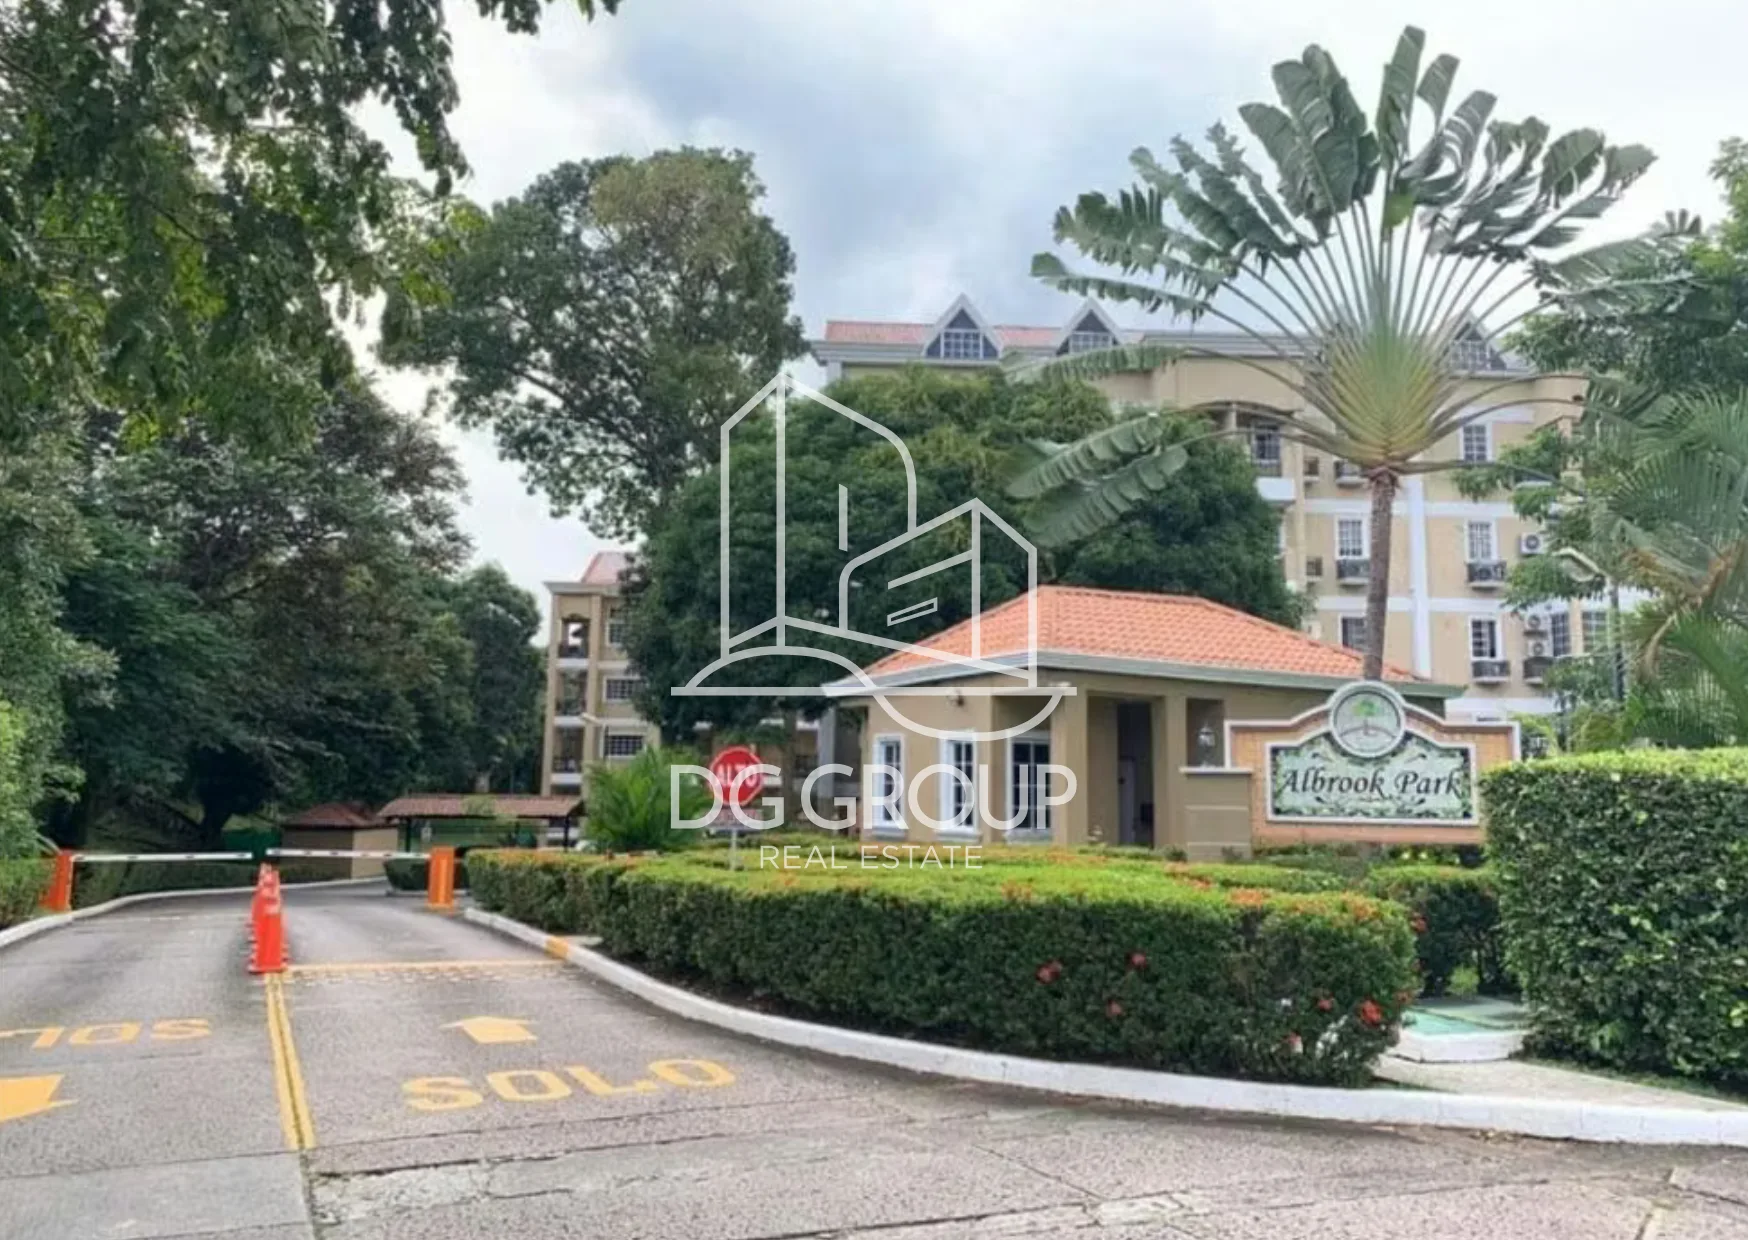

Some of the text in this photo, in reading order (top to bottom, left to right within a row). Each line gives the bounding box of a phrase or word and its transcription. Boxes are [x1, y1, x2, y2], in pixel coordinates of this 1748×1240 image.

[714, 763, 759, 788] ALTO
[1283, 766, 1463, 799] Albrook Park
[402, 1057, 736, 1112] SOLO
